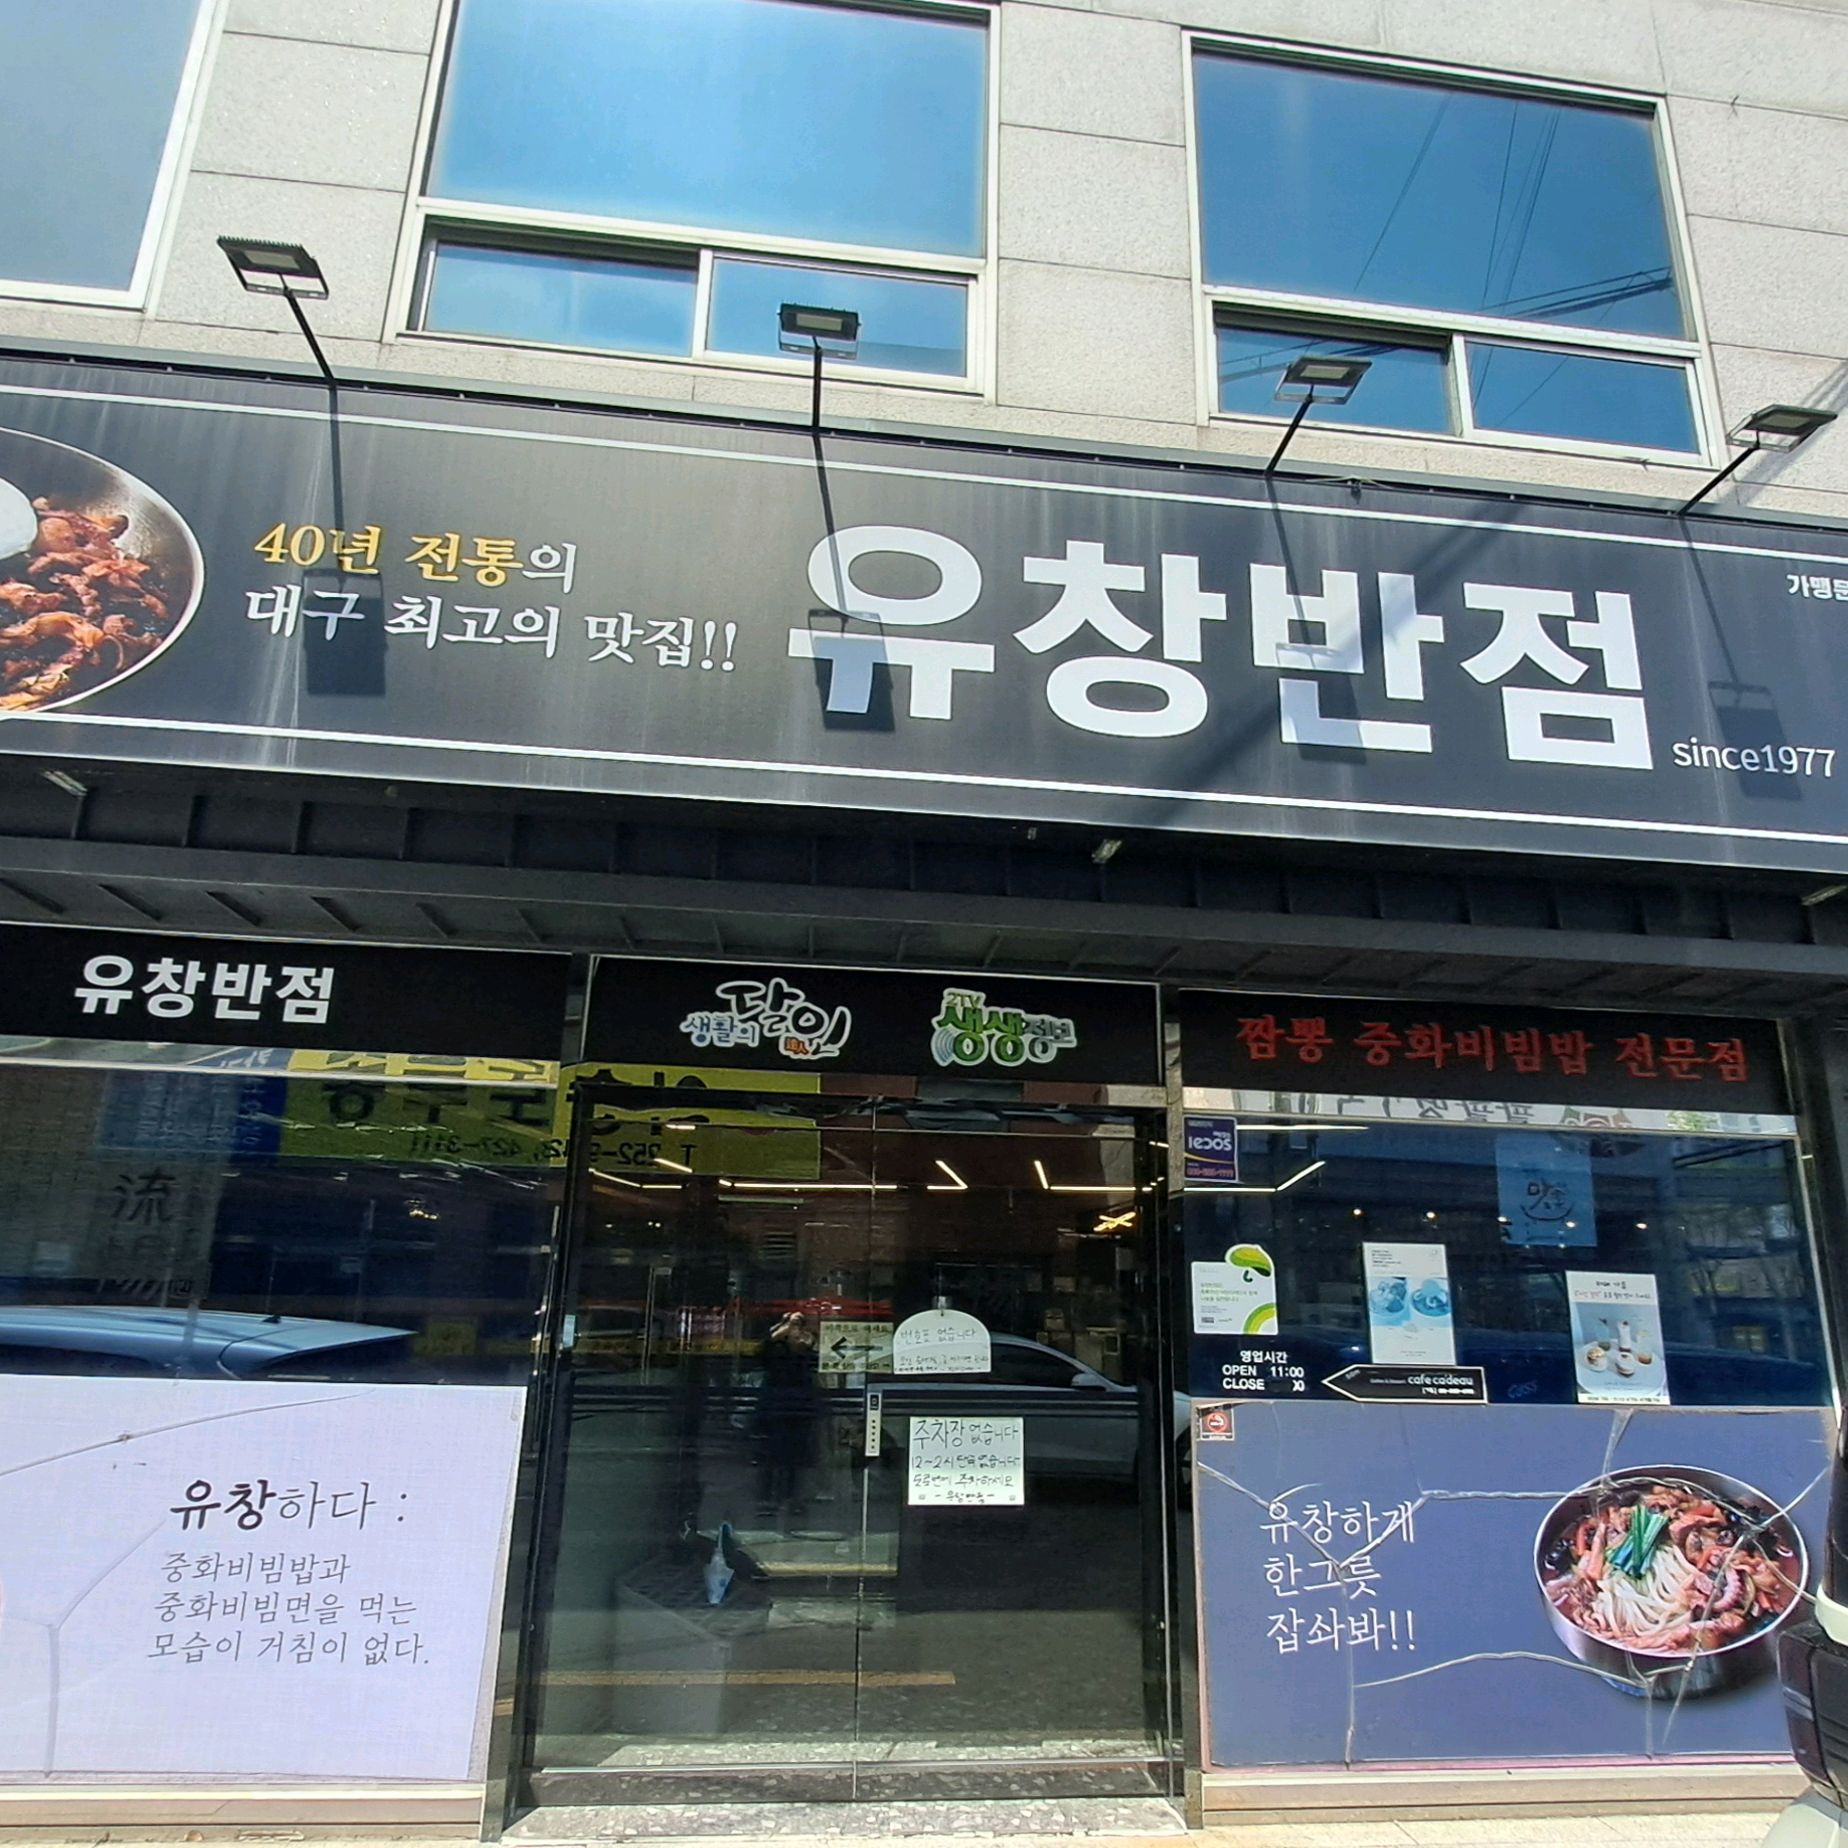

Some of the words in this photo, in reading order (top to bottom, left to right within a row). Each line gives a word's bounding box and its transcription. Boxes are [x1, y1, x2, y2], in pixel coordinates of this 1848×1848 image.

[254, 522, 382, 575] 40년
[404, 531, 578, 594] 전통의
[245, 583, 366, 641] 대구
[383, 595, 561, 660] 최고의
[583, 612, 738, 673] 맛집!!
[787, 525, 1655, 771] 유창반점
[1672, 736, 1837, 779] since1977
[73, 954, 335, 1025] 유창반점
[680, 1010, 760, 1047] 생활의
[715, 976, 853, 1059] 달인
[1236, 1014, 1335, 1064] 짬뽕
[1353, 1020, 1594, 1076] 중화비빔밥
[1615, 1033, 1749, 1082] 전문점
[1222, 1364, 1257, 1376] OPEN
[1270, 1365, 1305, 1378] 11:00
[1240, 1350, 1288, 1364] 영업시간
[1222, 1377, 1266, 1390] CLOSE
[913, 1418, 965, 1450] 주차장
[969, 1422, 1019, 1446] 없습니다
[170, 1479, 376, 1532] 유창하다
[1259, 1500, 1415, 1545] 유창하게
[160, 1552, 352, 1585] 중화비빔밥과
[1263, 1553, 1382, 1600] 한그릇
[153, 1591, 345, 1625] 중화비빔면을
[359, 1592, 418, 1625] 먹는
[147, 1631, 242, 1664] 모습이
[256, 1632, 348, 1665] 거침이
[364, 1633, 431, 1666] 없다.
[1266, 1607, 1416, 1655] 잡솨봐!!
